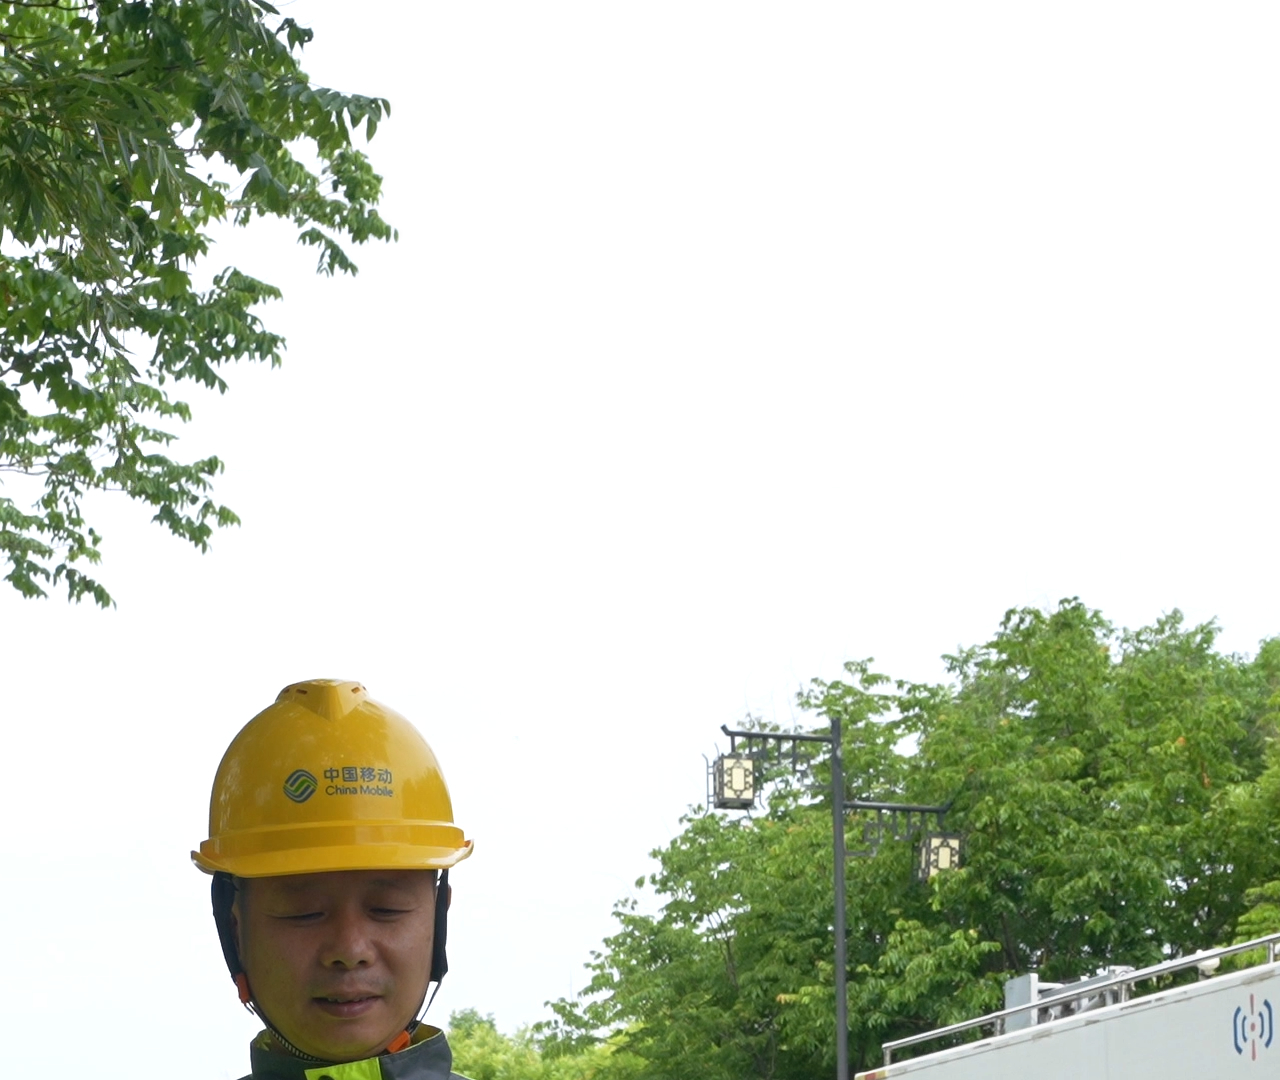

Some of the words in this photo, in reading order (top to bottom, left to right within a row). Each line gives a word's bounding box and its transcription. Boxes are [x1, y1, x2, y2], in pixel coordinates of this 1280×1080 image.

[323, 766, 393, 784] 中国移动
[325, 785, 358, 796] China
[360, 785, 393, 797] Mobile
